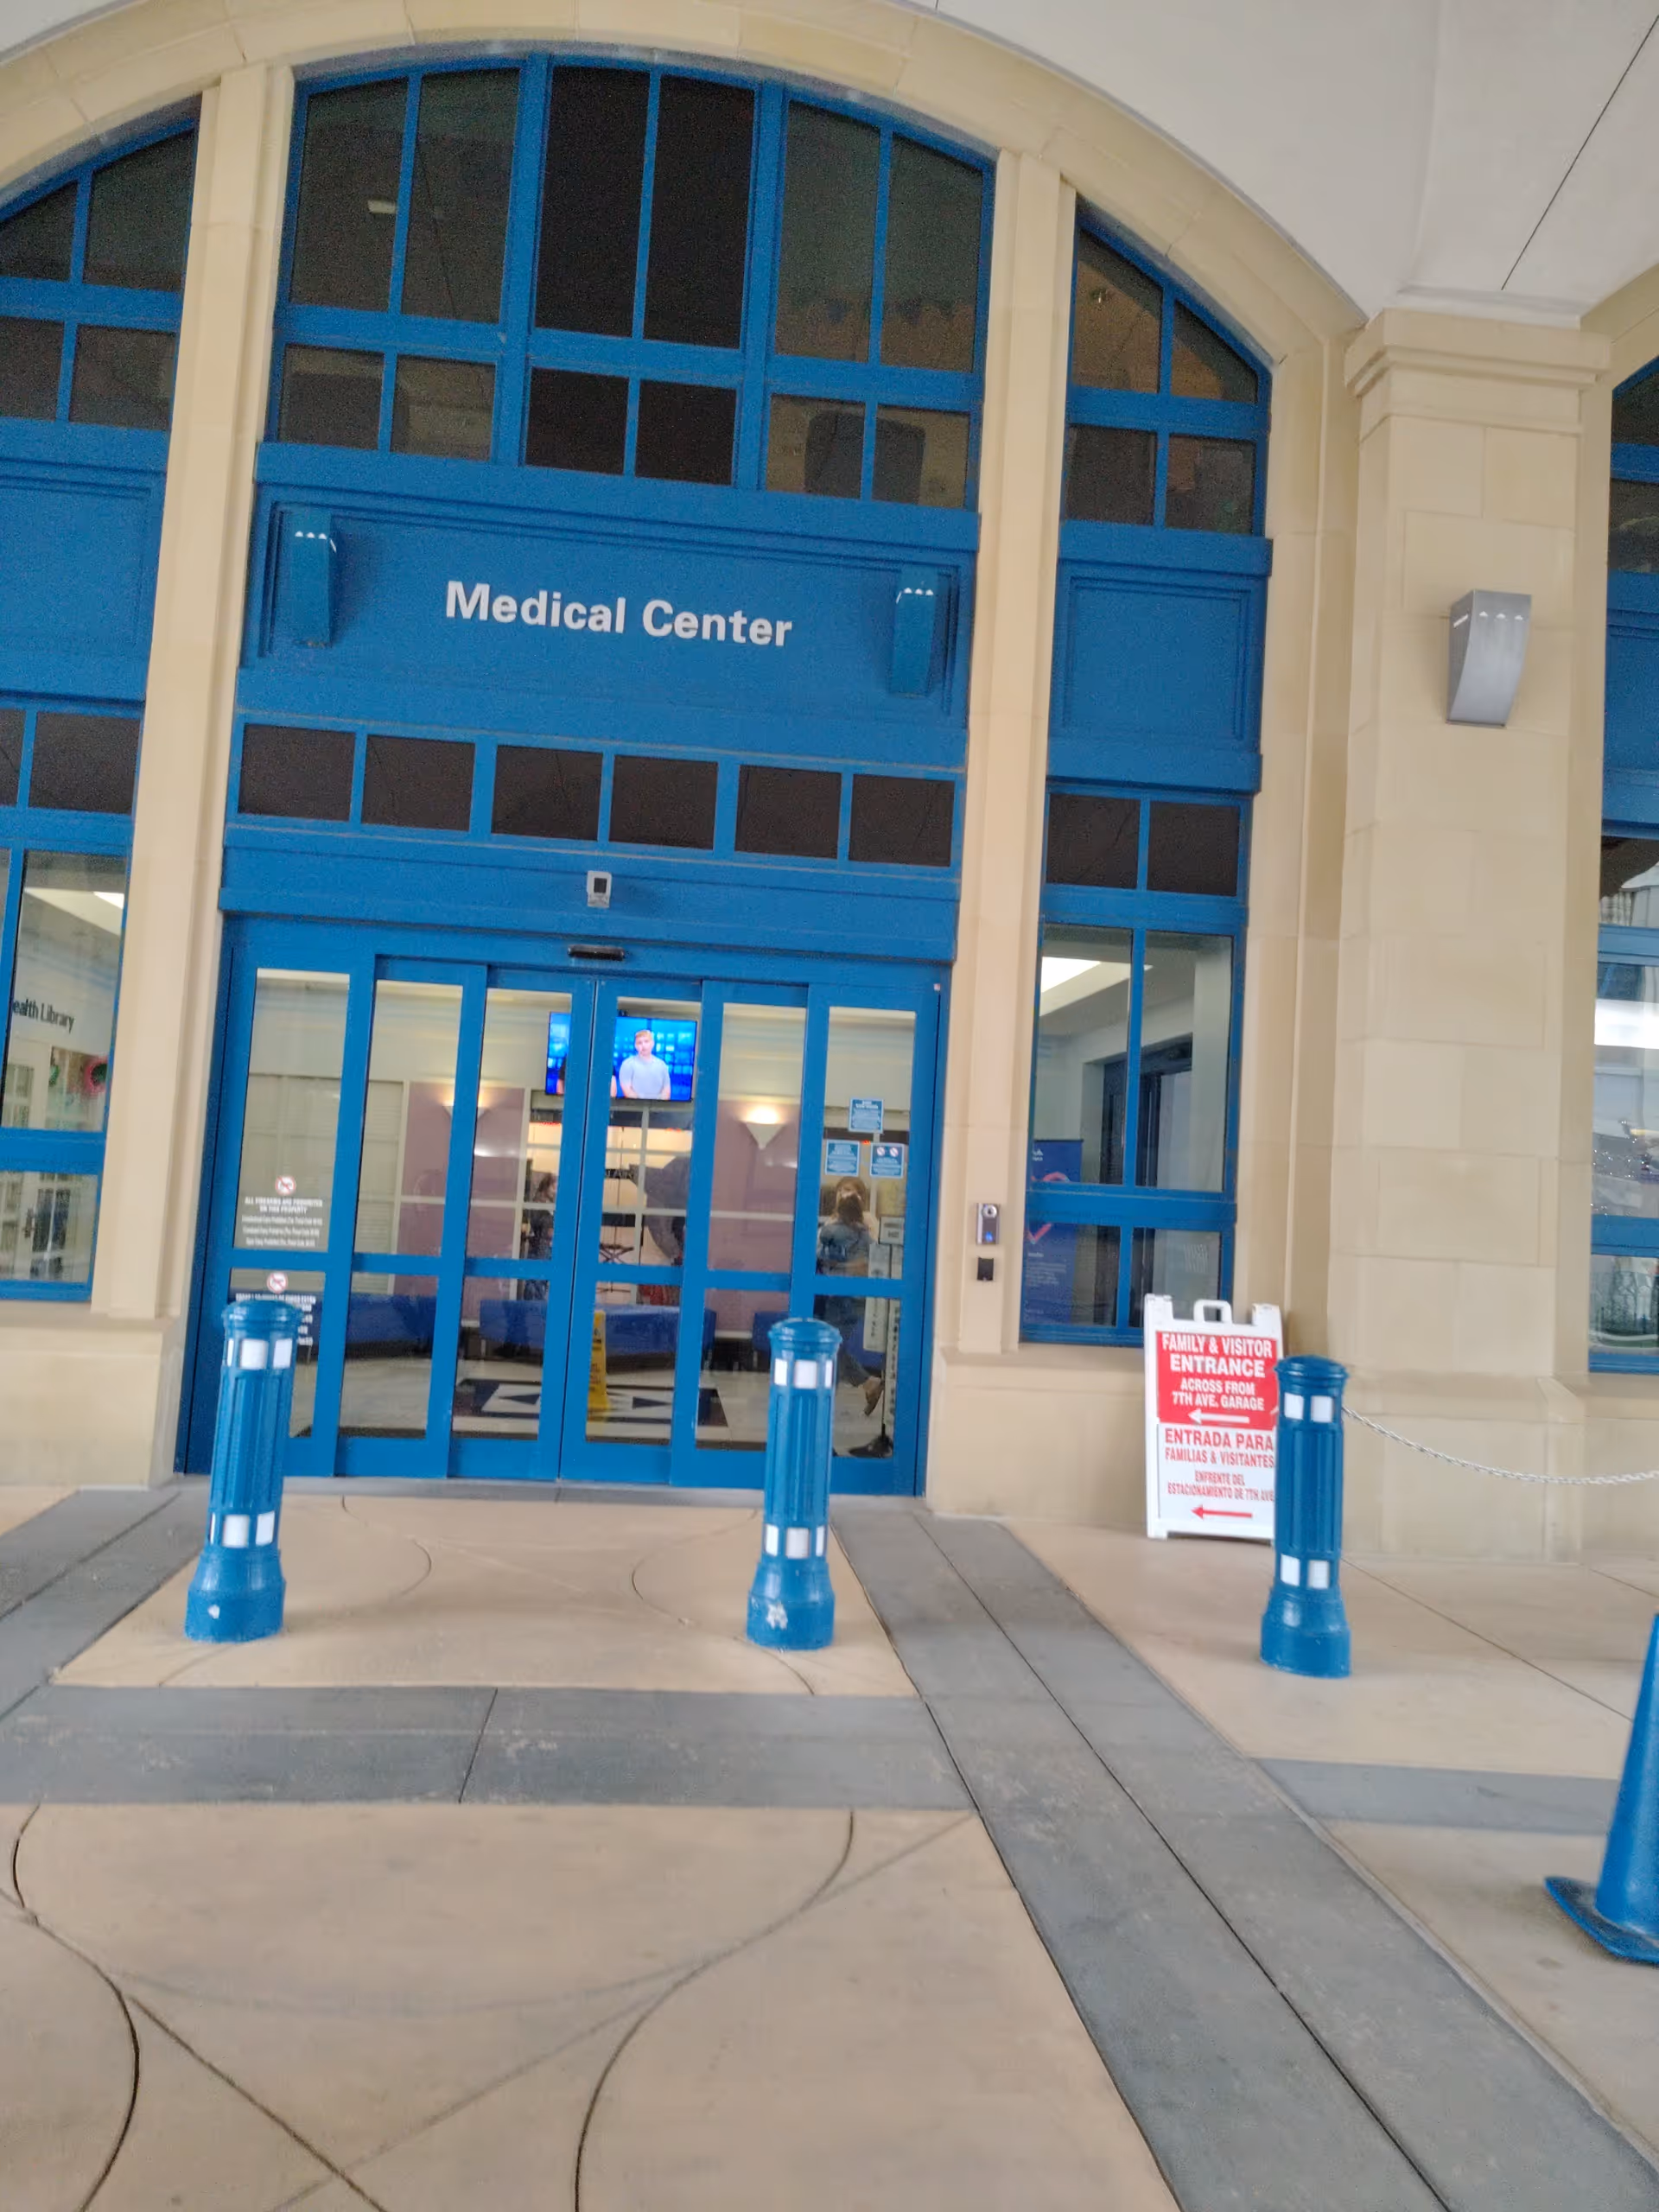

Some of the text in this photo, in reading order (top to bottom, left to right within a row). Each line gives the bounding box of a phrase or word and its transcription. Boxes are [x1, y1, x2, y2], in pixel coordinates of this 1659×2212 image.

[446, 580, 793, 647] Medical Center
[12, 999, 75, 1034] ealth Library
[1161, 1332, 1273, 1358] FAMILY & VISITOR
[1170, 1353, 1266, 1378] ENTRANCE
[1180, 1377, 1255, 1395] ACROSS FROM
[1172, 1391, 1265, 1411] 7TH AVE. GARAGE
[1165, 1427, 1274, 1452] ENTRADA PARA
[1165, 1447, 1274, 1469] FAMILIAS & VISITANTES
[1195, 1471, 1245, 1486] ENFRENTE DEL
[1167, 1482, 1232, 1499] ESTACIONAMIENTO
[1234, 1488, 1244, 1500] DE
[1244, 1488, 1260, 1501] 7TH
